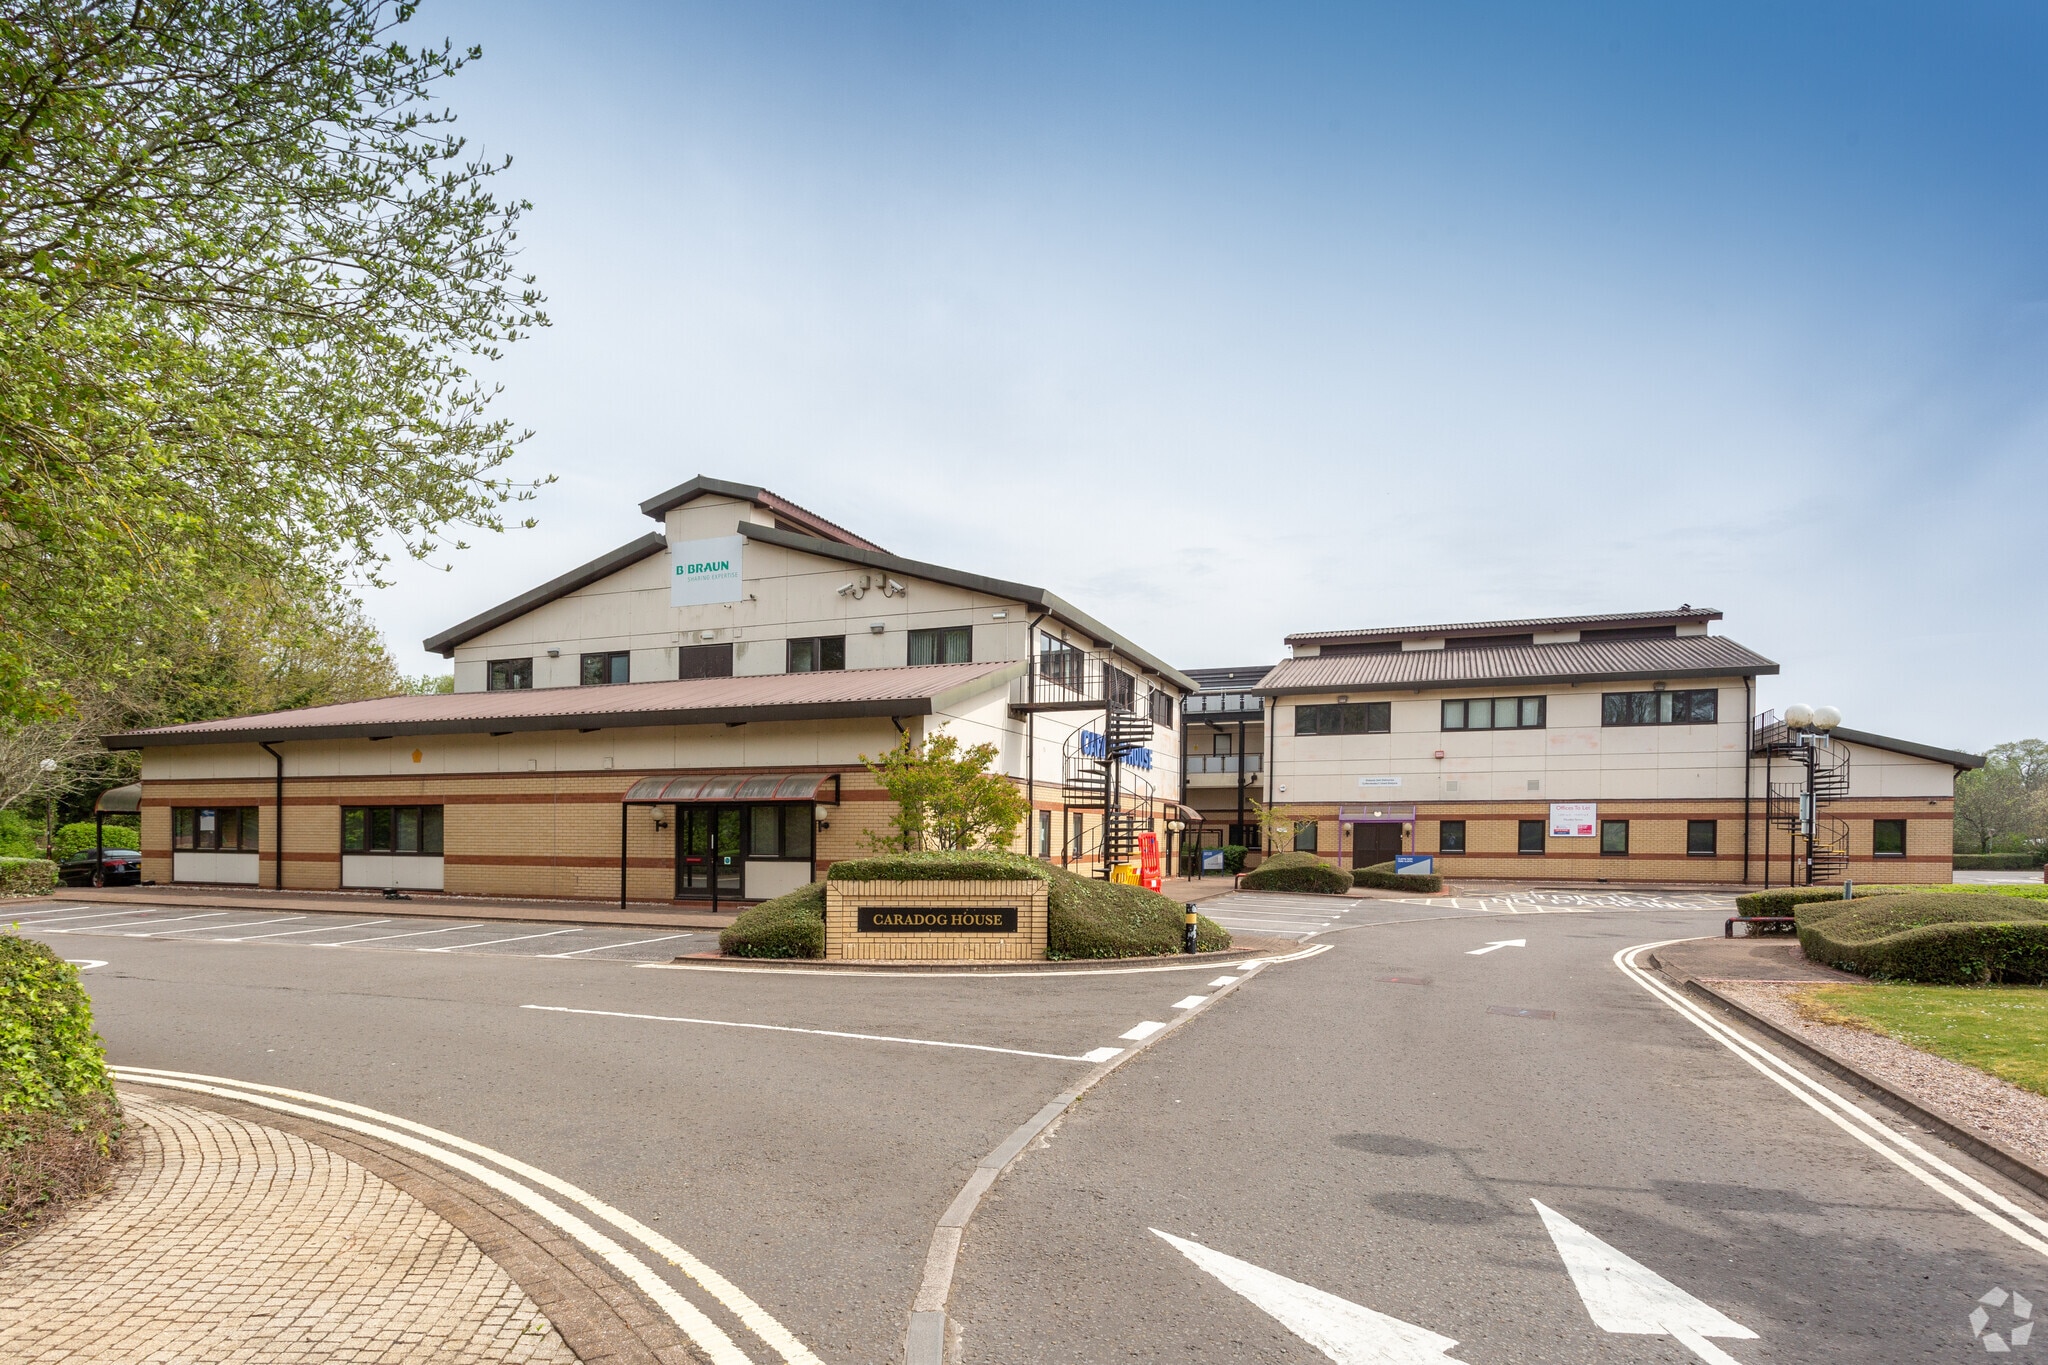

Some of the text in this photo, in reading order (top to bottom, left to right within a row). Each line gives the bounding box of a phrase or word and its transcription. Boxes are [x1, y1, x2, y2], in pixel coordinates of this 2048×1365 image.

[676, 561, 729, 575] B BRAUN
[687, 571, 738, 582] SHARING EXPERTISE
[873, 913, 1003, 925] CARADOG HOUSE
